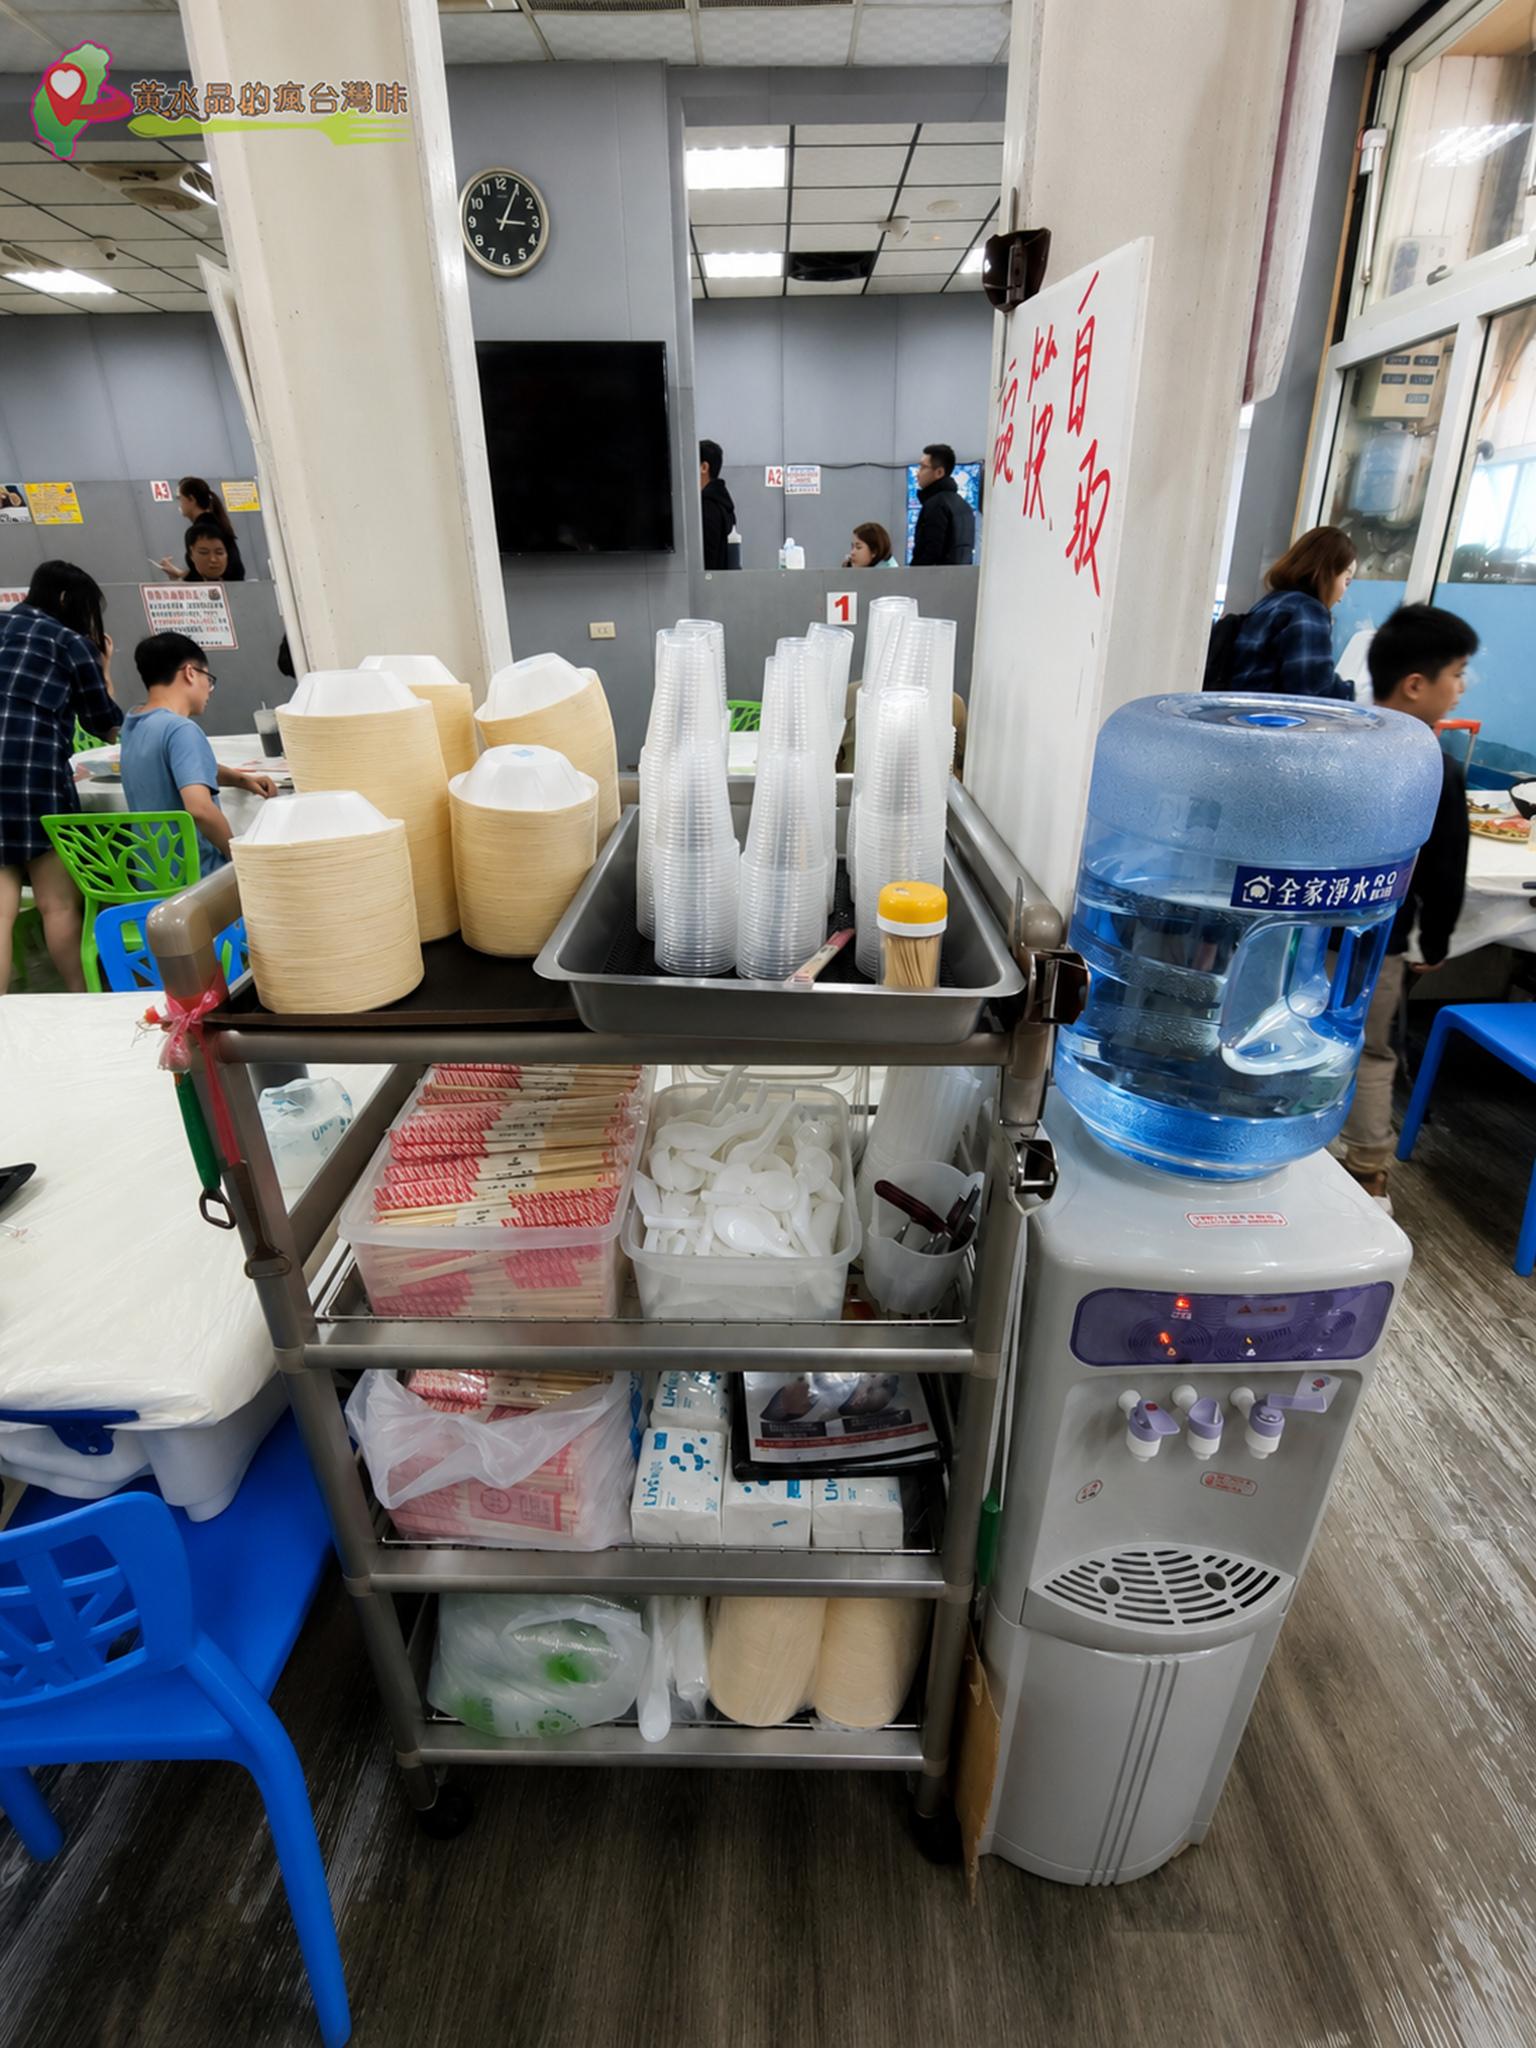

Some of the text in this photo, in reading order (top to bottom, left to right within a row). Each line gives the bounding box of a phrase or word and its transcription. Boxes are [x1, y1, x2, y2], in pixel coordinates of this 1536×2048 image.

[481, 183, 491, 196] 11
[494, 177, 507, 191] 12
[471, 198, 484, 210] 10
[525, 197, 535, 210] 2
[468, 215, 477, 229] 9
[531, 215, 540, 229] 3
[475, 234, 484, 247] 8
[528, 233, 538, 246] 4
[487, 247, 497, 260] 7
[502, 253, 511, 265] 6
[517, 247, 527, 260] 5
[1065, 269, 1111, 598] 自取
[767, 468, 782, 486] A2
[153, 483, 171, 500] A3
[834, 595, 849, 622] 1
[1276, 875, 1371, 907] 全家淨水
[1373, 871, 1398, 887] RO
